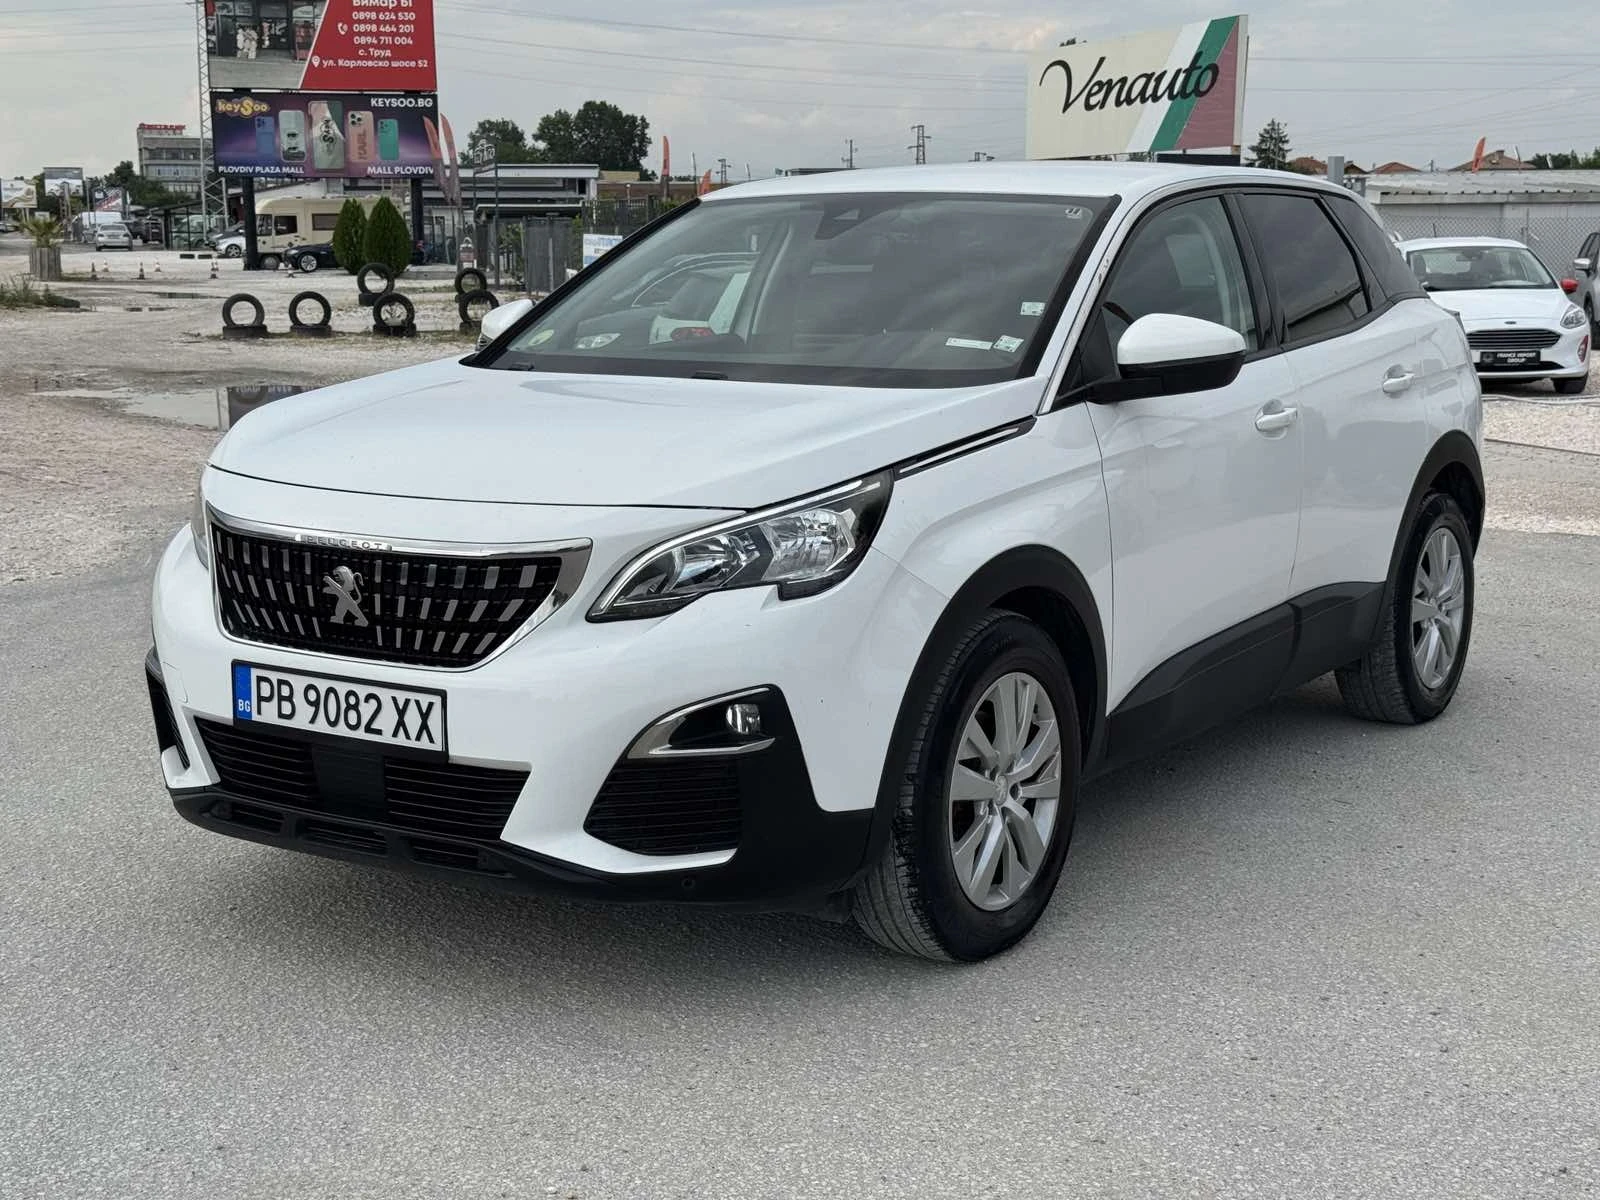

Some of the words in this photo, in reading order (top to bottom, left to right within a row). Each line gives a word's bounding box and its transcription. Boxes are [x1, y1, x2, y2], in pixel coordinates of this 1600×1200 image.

[352, 11, 376, 20] 0898
[379, 12, 396, 20] 624
[398, 12, 416, 20] 530
[353, 24, 377, 32] 0898
[379, 24, 397, 32] 464
[399, 25, 414, 33] 201
[353, 36, 377, 45] 0894
[394, 37, 413, 45] 004
[369, 48, 392, 57] Труд
[322, 60, 336, 68] ул.
[338, 59, 389, 68] Карловско
[1039, 51, 1219, 114] Venauto
[370, 98, 433, 107] KEYSOO.BG
[218, 166, 254, 174] PLOVDIV
[255, 166, 280, 174] PLAZA
[282, 166, 304, 174] MALL
[367, 166, 393, 174] MALL
[394, 166, 434, 175] PLOVDIV
[305, 535, 384, 551] PEUGEOT
[237, 698, 251, 712] BG
[255, 675, 296, 720] PB
[303, 683, 383, 735] 9082
[391, 695, 435, 744] XX
